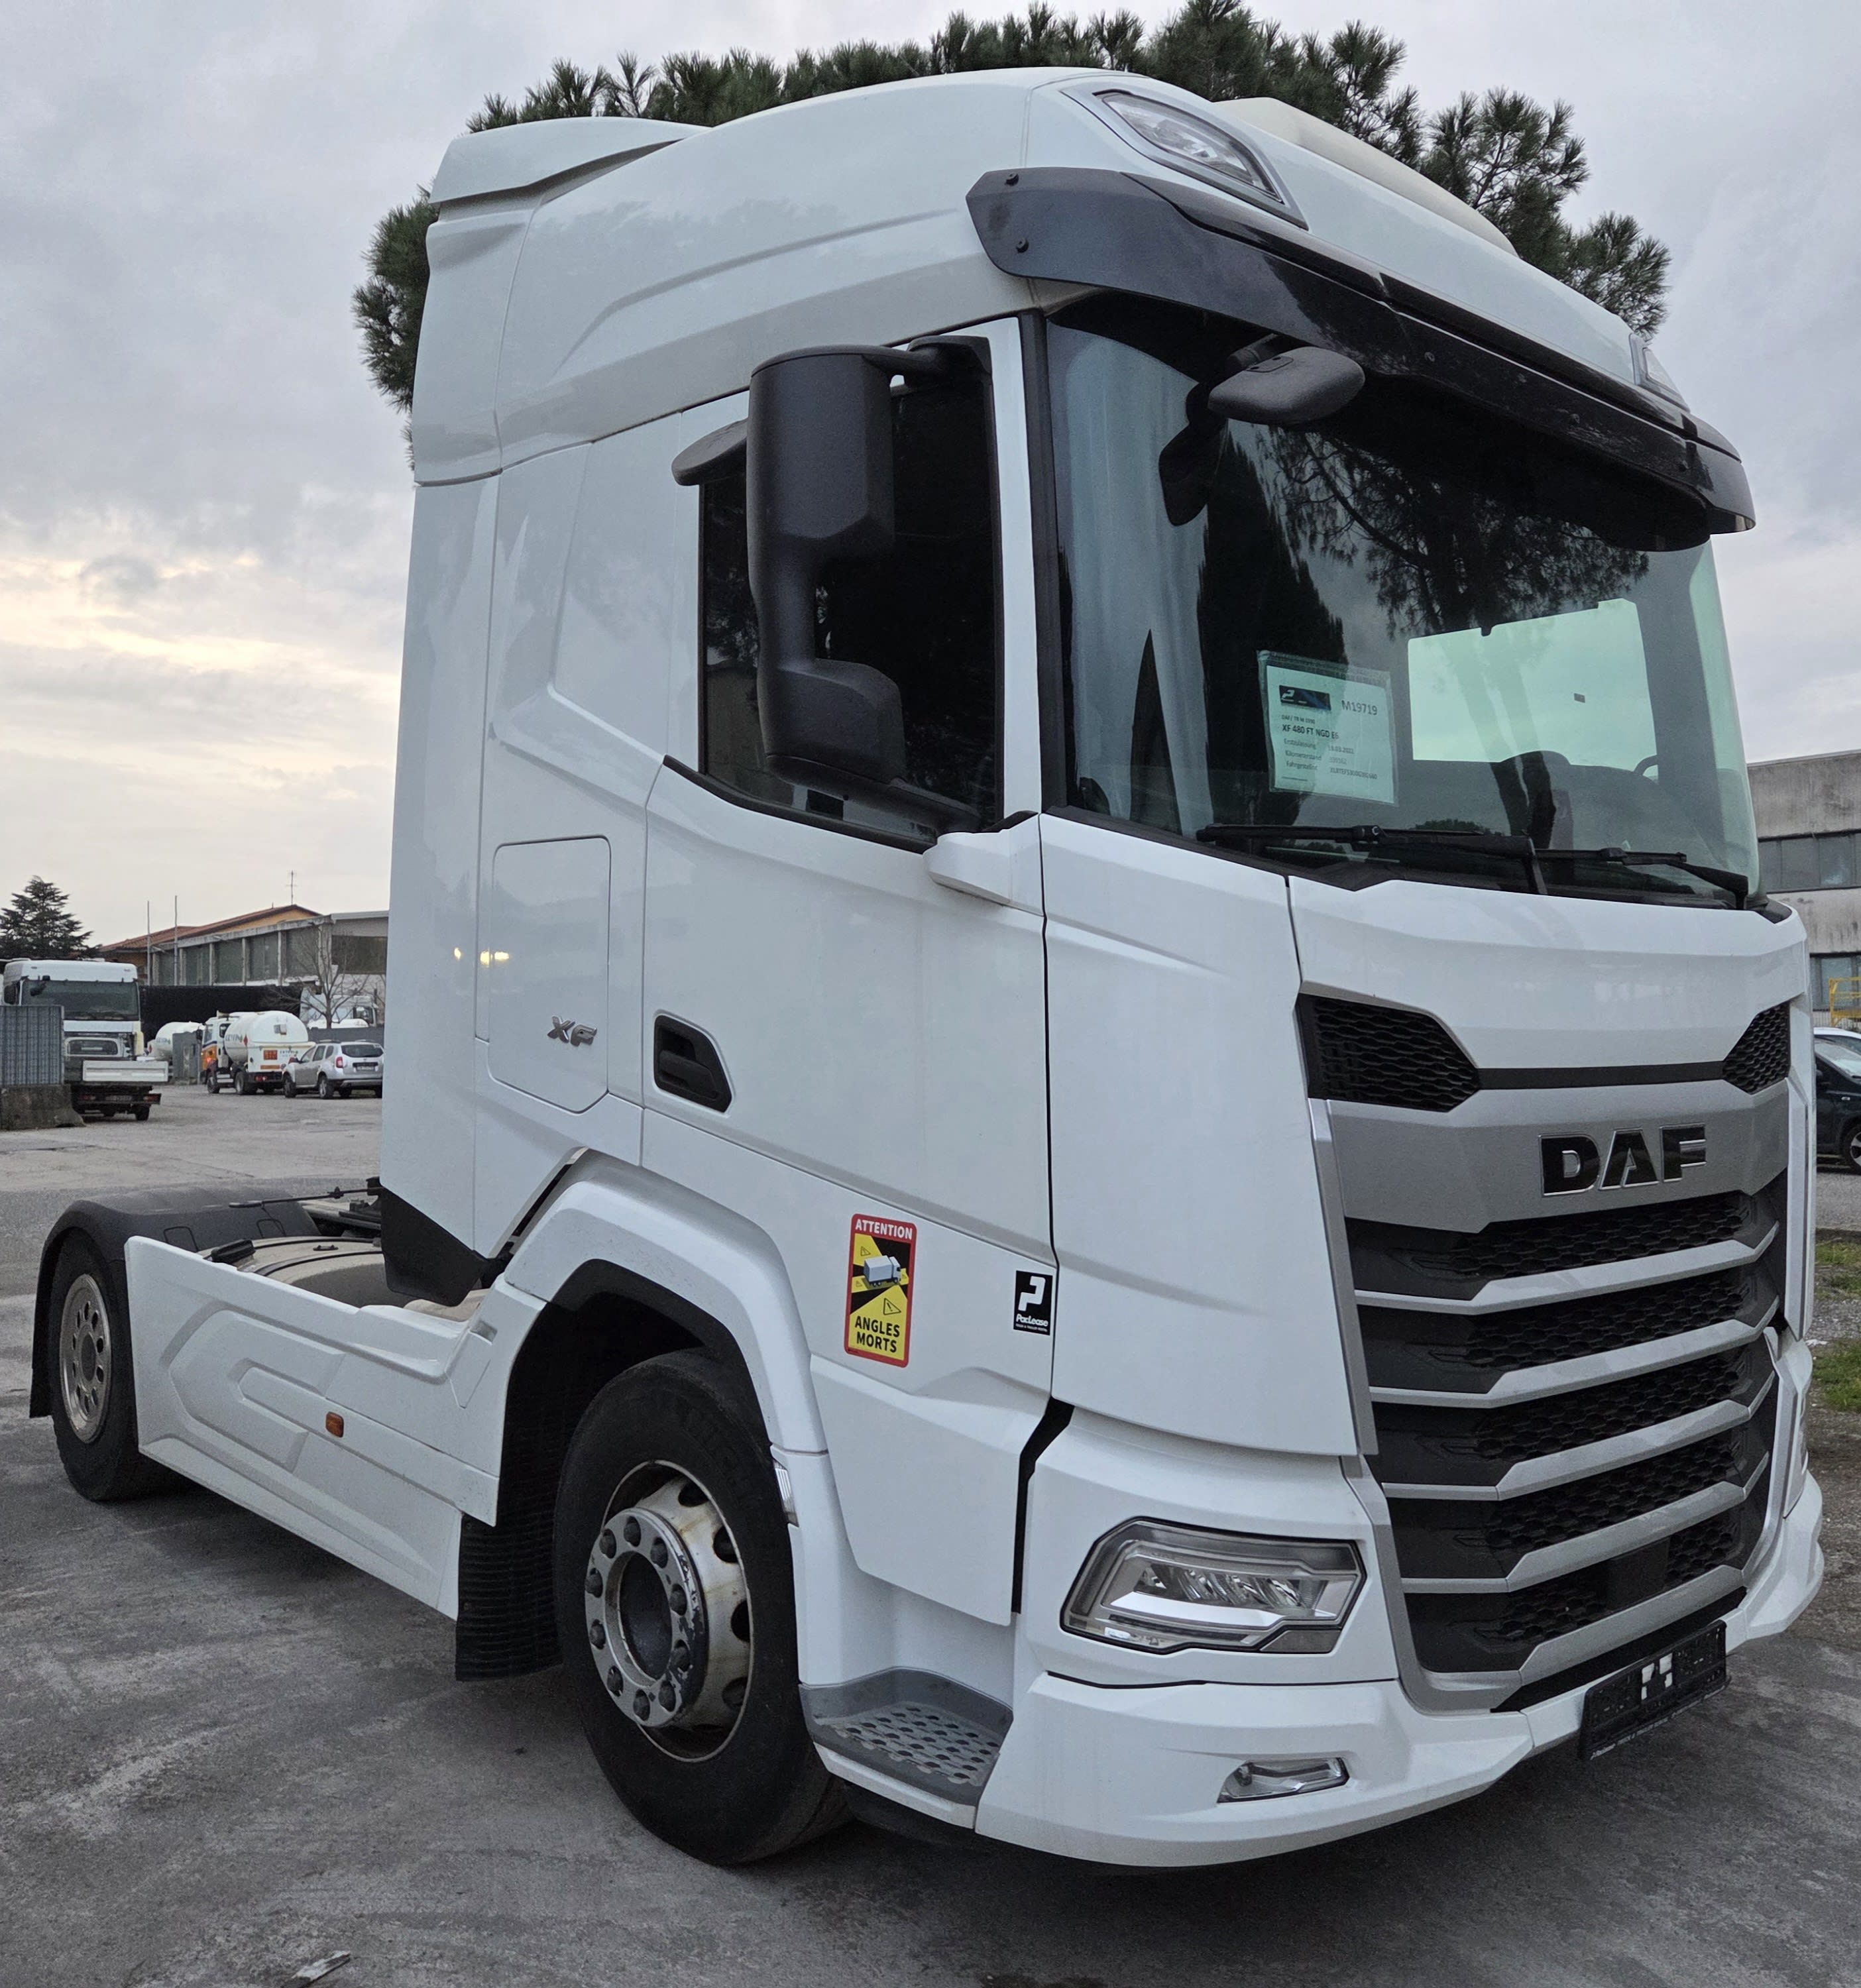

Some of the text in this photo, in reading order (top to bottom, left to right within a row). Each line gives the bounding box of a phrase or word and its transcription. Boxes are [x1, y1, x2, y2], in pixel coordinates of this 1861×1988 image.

[1341, 700, 1378, 715] M19719
[1292, 725, 1305, 734] 480
[1316, 729, 1330, 738] NGD
[1538, 1123, 1707, 1197] DAF
[856, 1219, 913, 1240] ATTENTION
[855, 1315, 900, 1337] ANGLES
[1015, 1313, 1048, 1327] PacLease
[856, 1331, 897, 1353] MORTS
